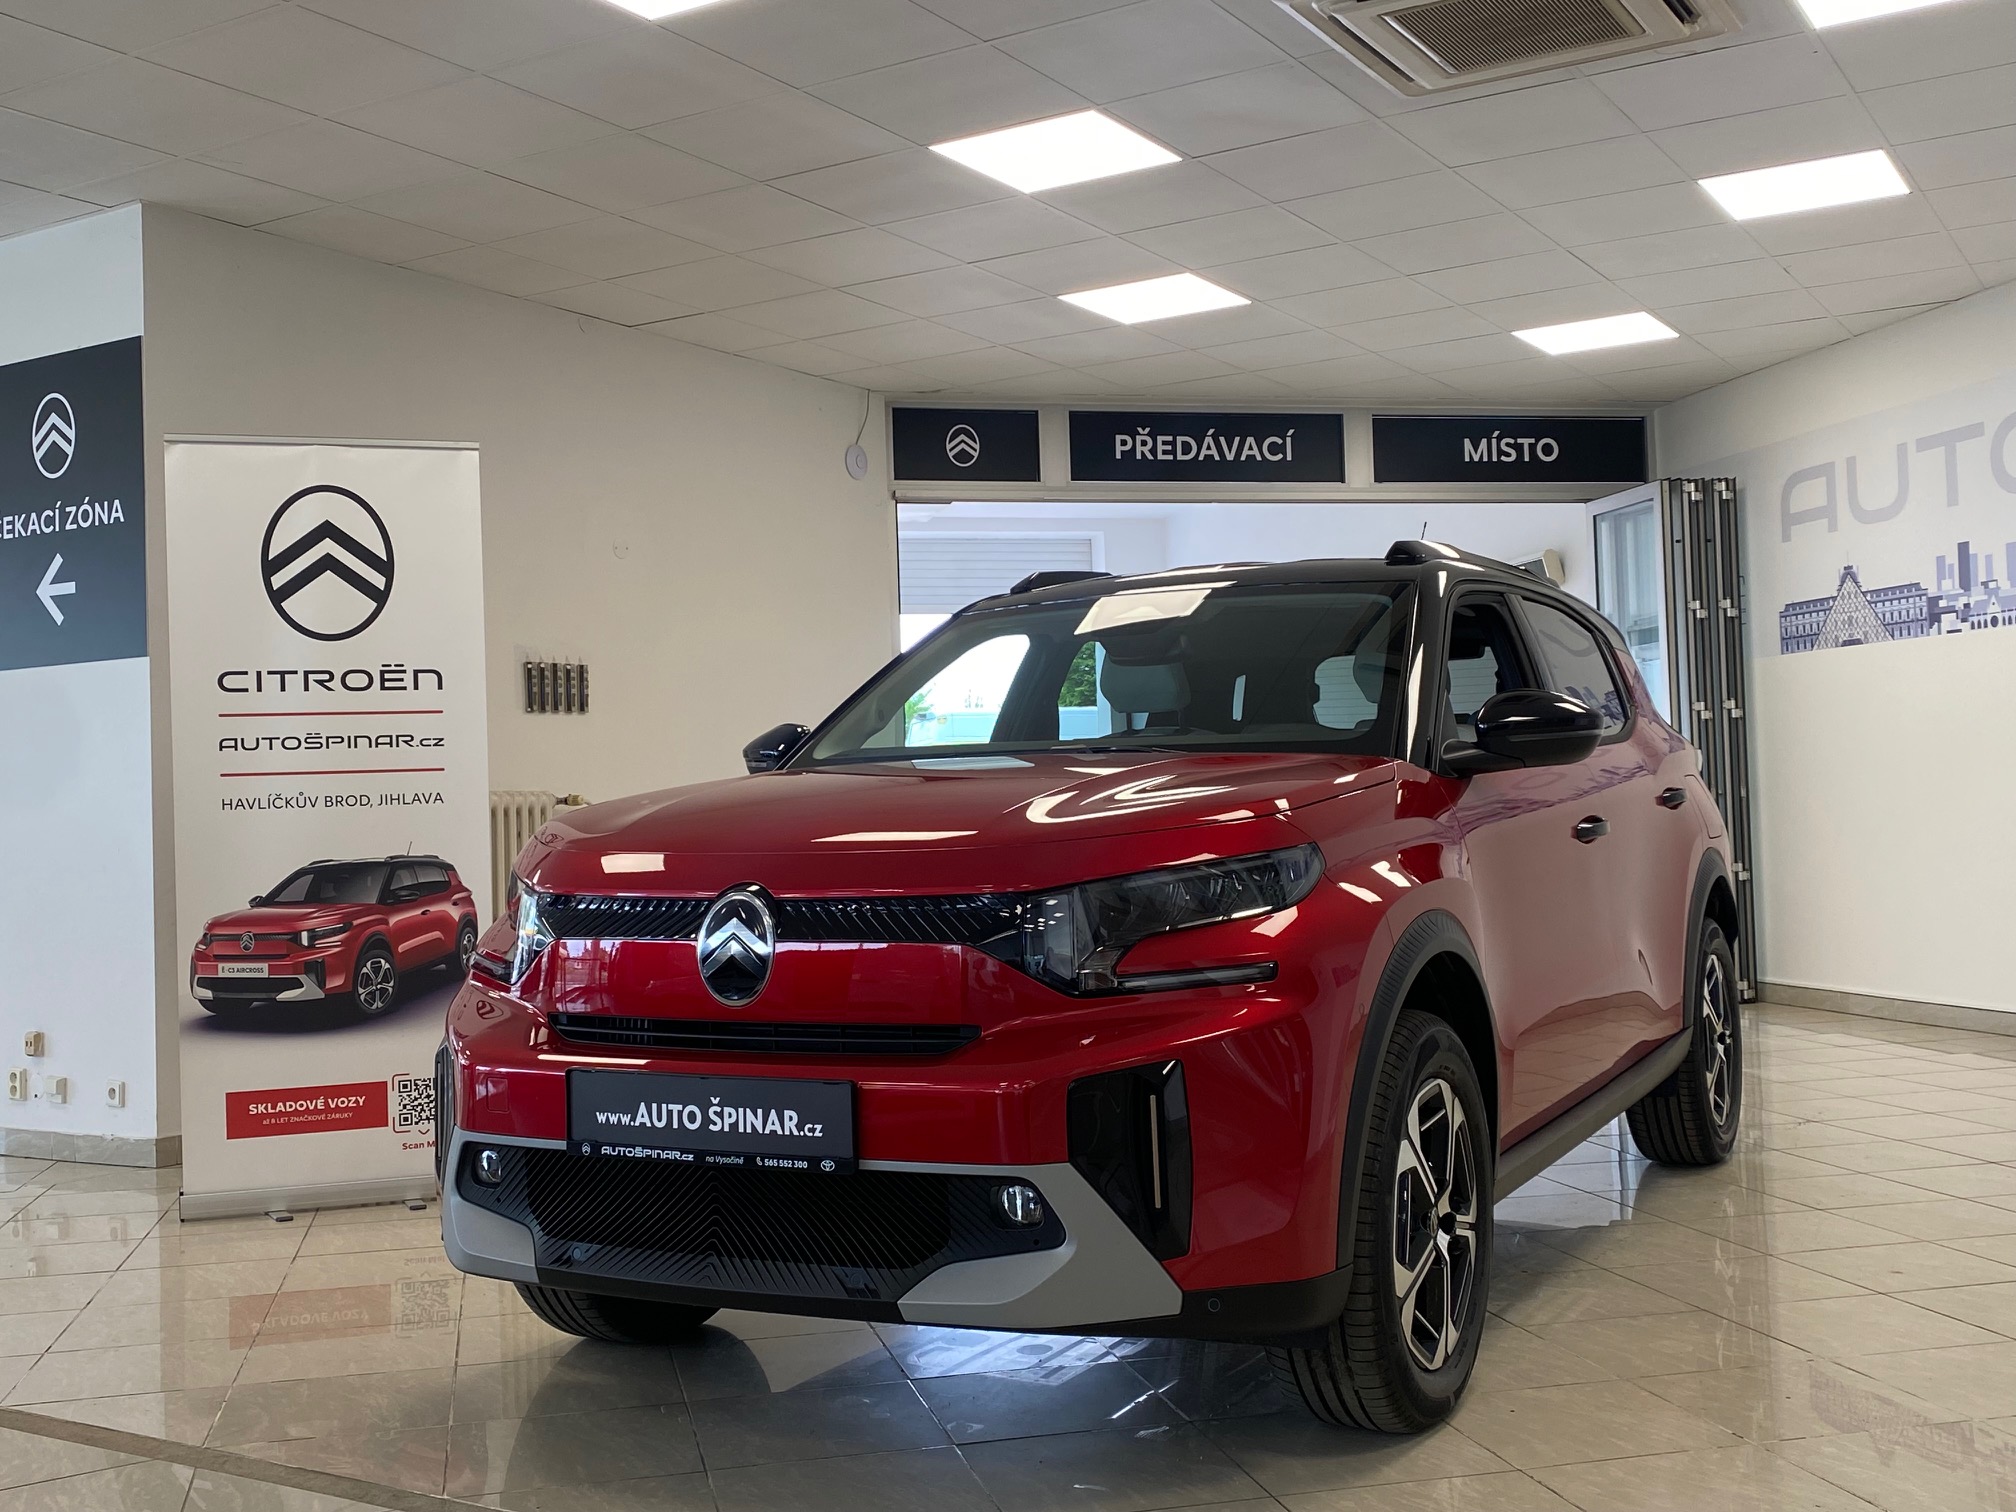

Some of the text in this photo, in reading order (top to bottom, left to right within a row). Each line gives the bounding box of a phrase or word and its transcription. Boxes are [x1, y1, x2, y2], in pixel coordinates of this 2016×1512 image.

[1114, 427, 1559, 463] PŘEDÁVACÍ MÍSTO
[65, 496, 125, 531] ZÓNA
[217, 663, 444, 693] CITROËN
[218, 732, 446, 752] AUTOŠPINAR.cz
[221, 791, 444, 811] HAVLÍČKŮV BROD, JIHLAVA
[248, 1095, 366, 1115] SKLADOVÉ VOZY
[289, 1113, 326, 1123] ZNAČKOVÉ
[327, 1111, 353, 1120] ZÁRUKY
[595, 1096, 823, 1137] www.AUTO ŠPINAR.cz
[402, 1140, 436, 1151] Scan M
[705, 1155, 715, 1163] na
[715, 1155, 744, 1165] Vysočině
[764, 1158, 778, 1167] 565
[779, 1159, 793, 1168] 552
[793, 1160, 808, 1169] 300
